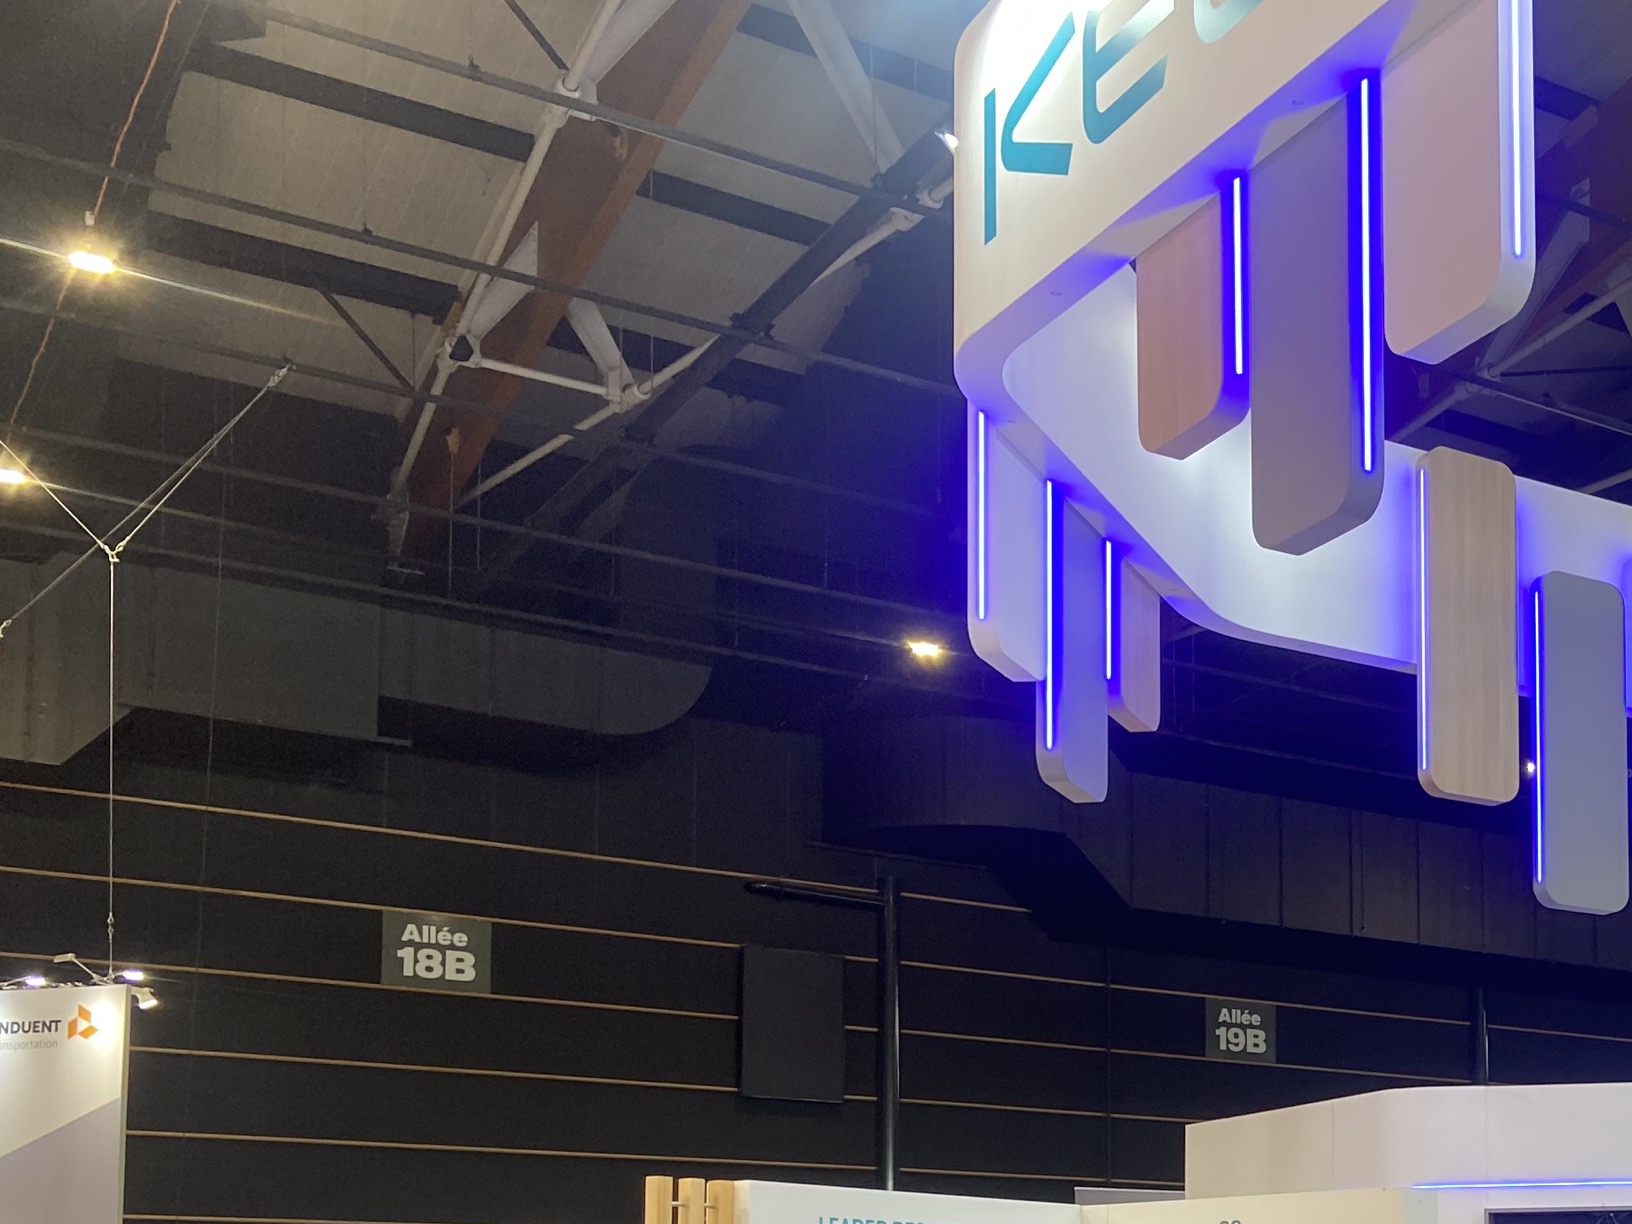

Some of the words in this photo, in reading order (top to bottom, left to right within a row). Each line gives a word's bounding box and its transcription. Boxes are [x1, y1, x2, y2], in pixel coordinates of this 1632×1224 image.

[401, 923, 469, 947] Allée
[396, 946, 477, 982] 18B
[1217, 1007, 1262, 1026] Allée
[1215, 1026, 1267, 1054] 19B
